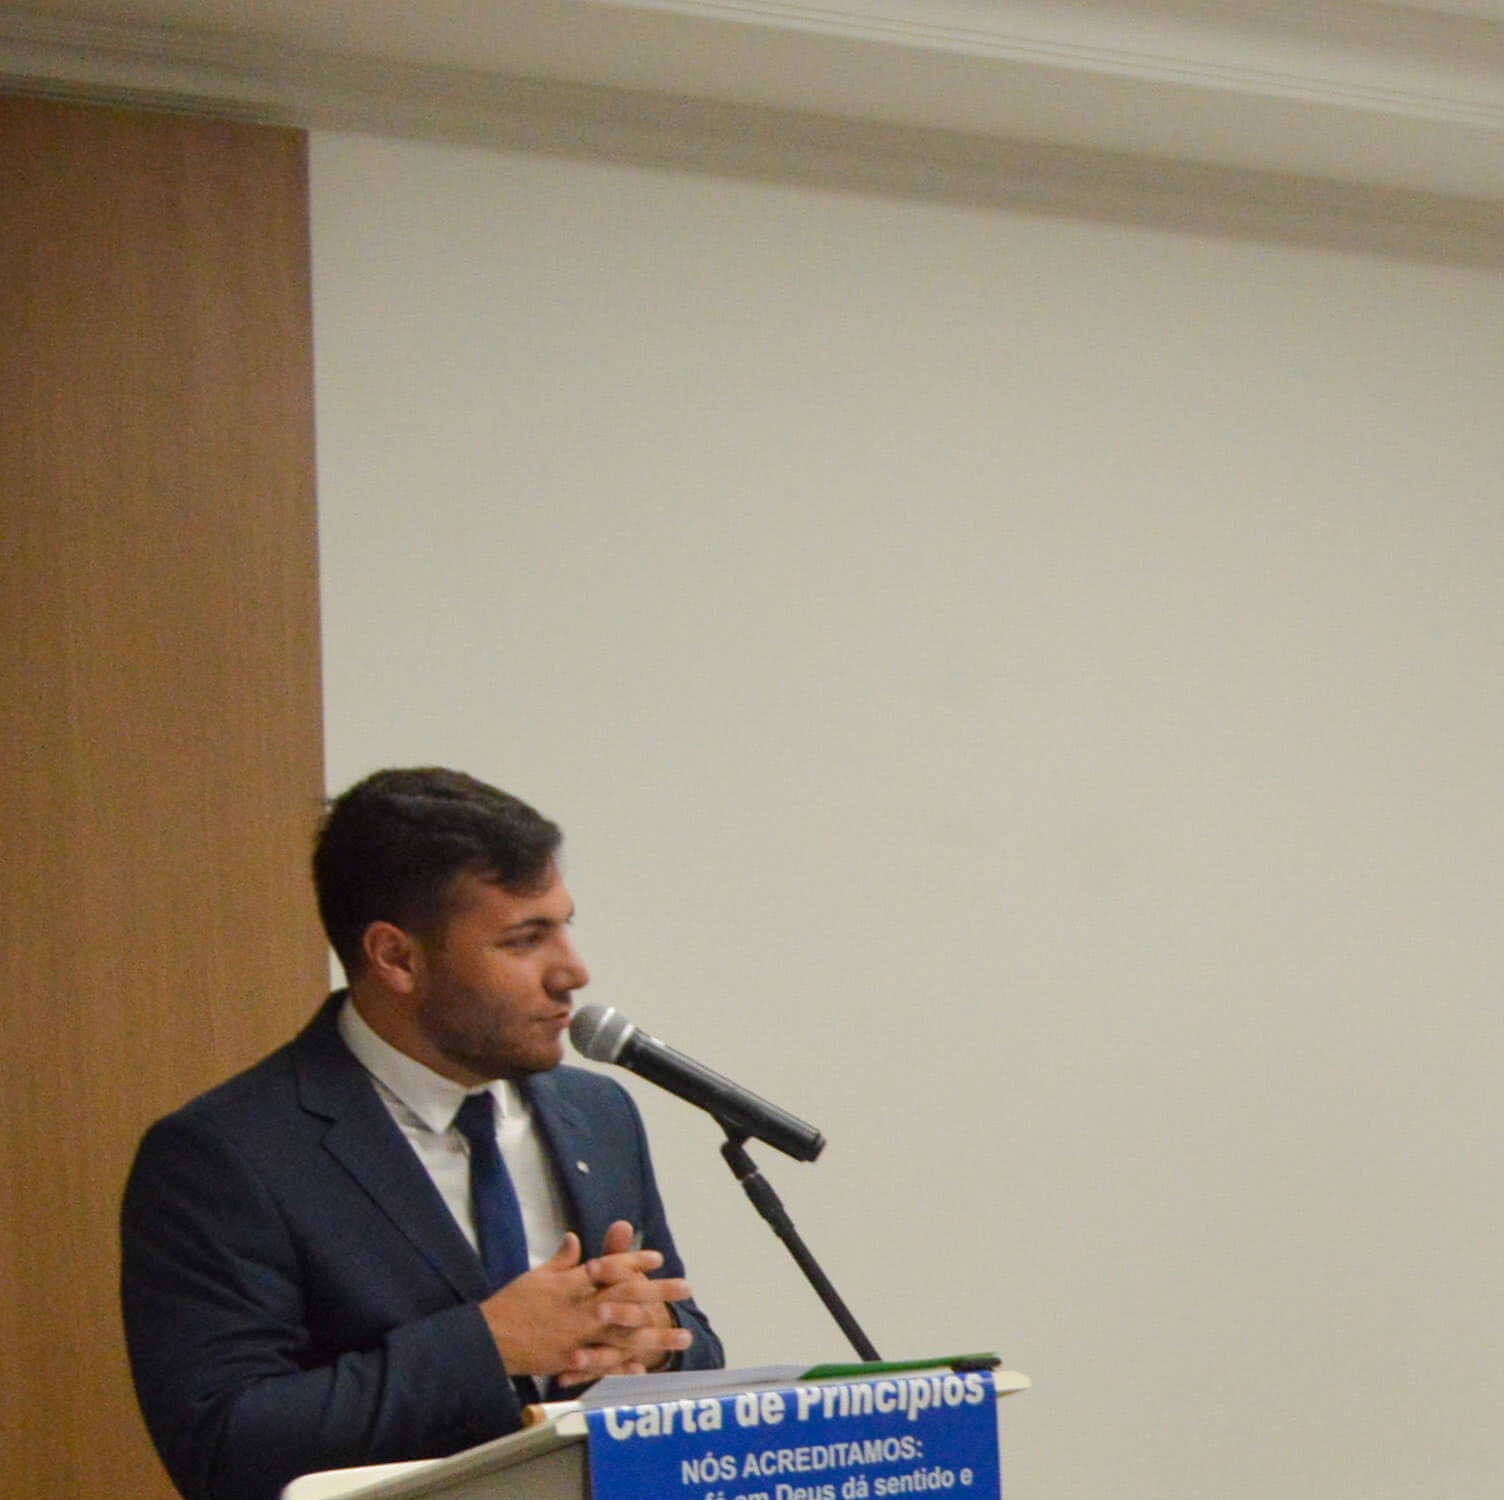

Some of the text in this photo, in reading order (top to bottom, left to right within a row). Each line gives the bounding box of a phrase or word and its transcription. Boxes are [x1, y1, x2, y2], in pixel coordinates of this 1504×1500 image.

[604, 1398, 722, 1440] Carta
[735, 1392, 786, 1428] de
[681, 1435, 923, 1485] NÓS ACREDITAMOS:
[841, 1474, 869, 1500] dá
[873, 1466, 955, 1497] sentido
[959, 1467, 974, 1486] e
